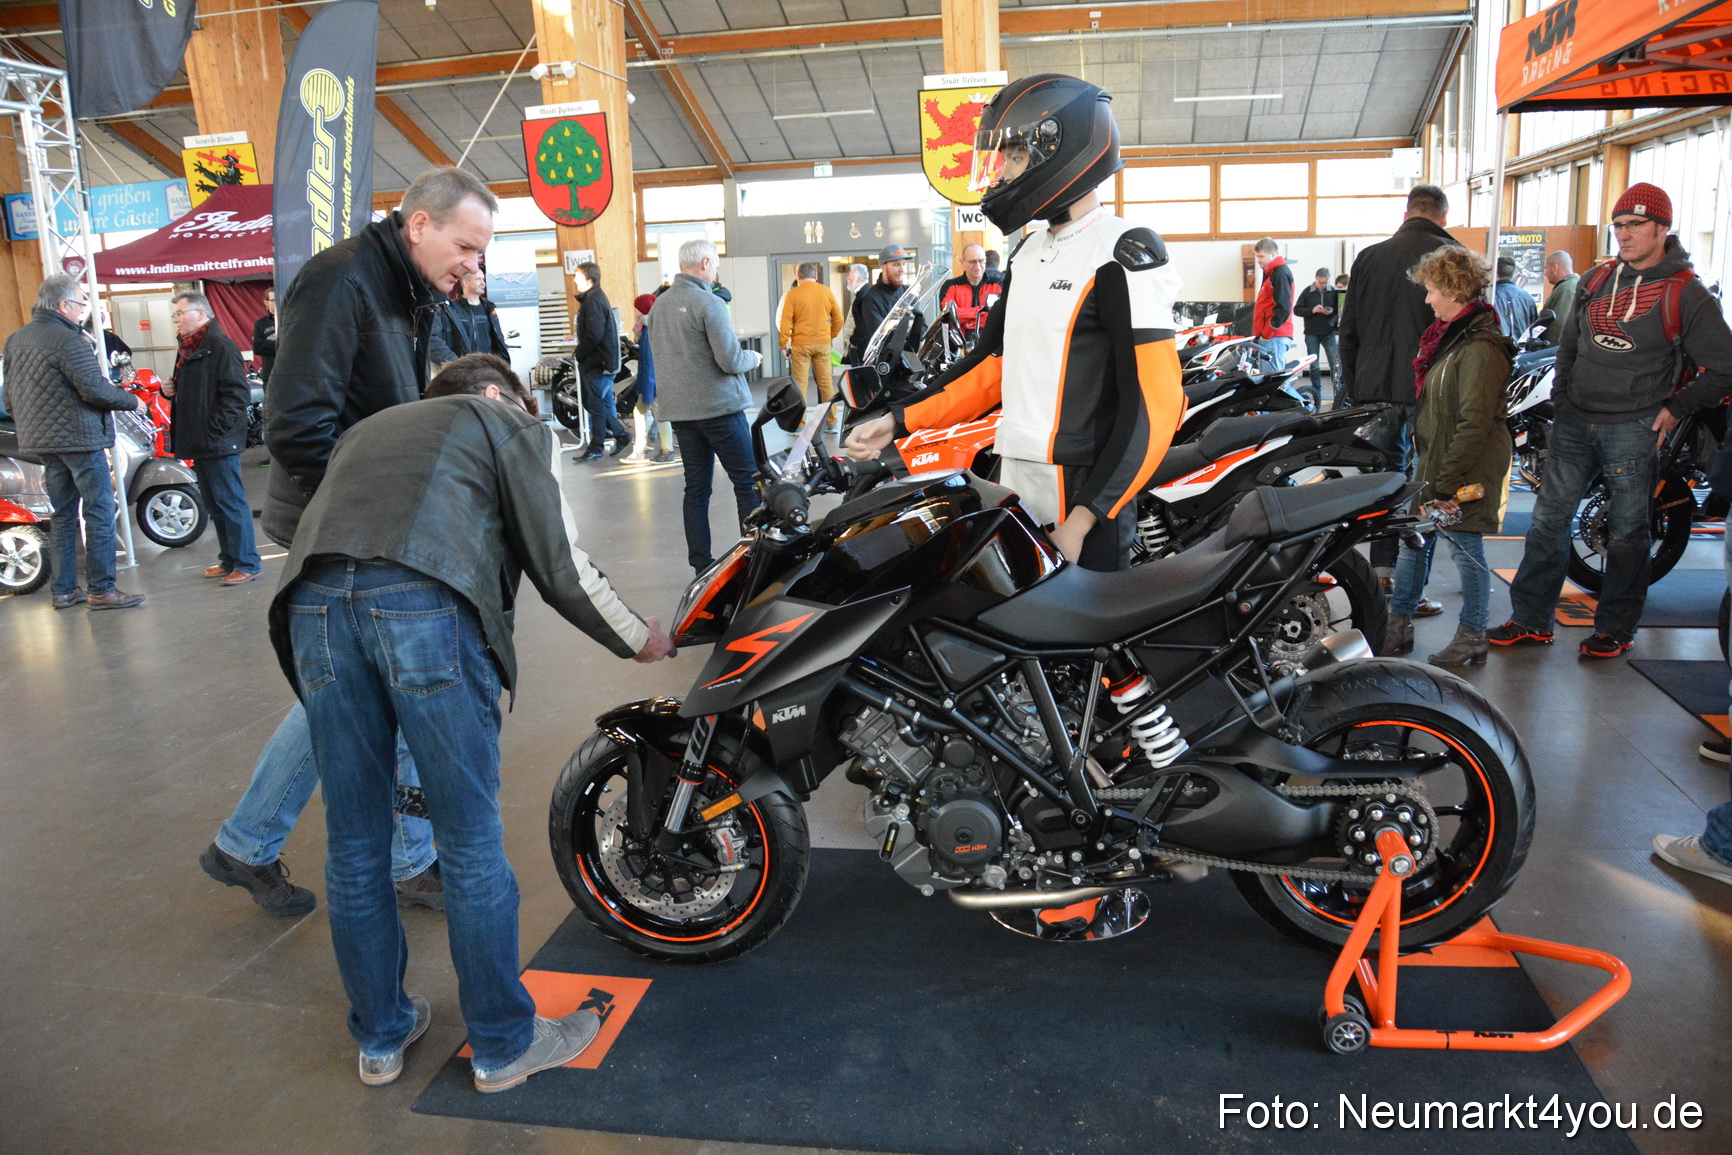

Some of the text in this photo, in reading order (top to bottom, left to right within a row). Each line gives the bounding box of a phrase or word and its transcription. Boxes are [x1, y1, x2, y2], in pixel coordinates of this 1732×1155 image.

[1525, 0, 1578, 63] KTM
[342, 76, 355, 174] Deutschlands
[98, 184, 151, 215] grüßen
[114, 208, 159, 228] Gäste!
[962, 212, 983, 223] WC
[1049, 279, 1073, 291] KTM
[911, 452, 940, 468] KTM
[772, 705, 806, 724] KTM
